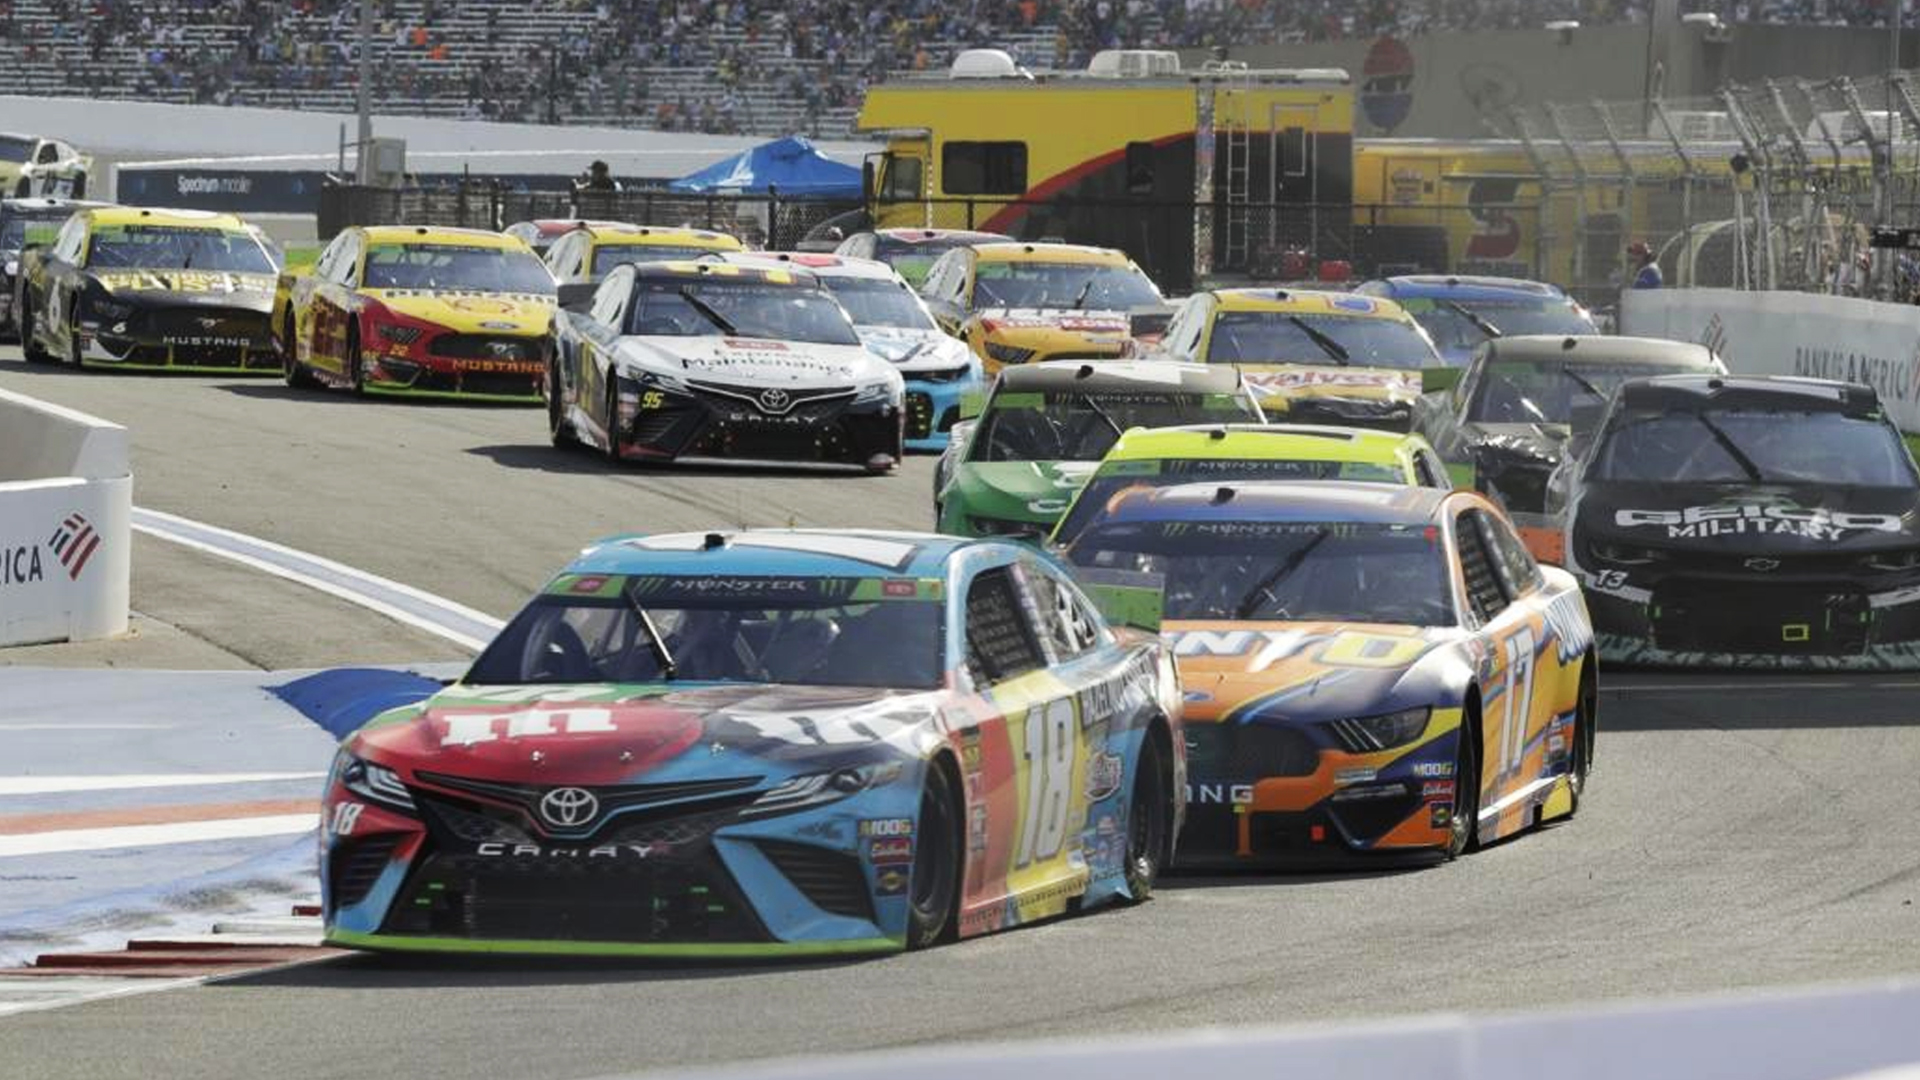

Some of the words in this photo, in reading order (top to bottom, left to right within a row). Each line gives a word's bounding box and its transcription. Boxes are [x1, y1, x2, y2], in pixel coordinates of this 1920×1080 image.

[177, 174, 219, 196] Spectrum
[112, 322, 127, 334] 6
[163, 336, 251, 346] MUSTANG
[452, 359, 546, 373] MUSTANG
[681, 357, 854, 377] Maintenance
[642, 391, 665, 409] 95
[1199, 461, 1301, 471] MONSTER
[1614, 505, 1902, 532] GEICO
[1668, 516, 1845, 541] MILITARY
[0, 545, 43, 584] ICA
[672, 579, 807, 592] MONSTER
[1596, 569, 1629, 588] 13
[1500, 626, 1537, 776] 17
[1412, 762, 1453, 776] MOOG
[1016, 697, 1076, 869] 18
[333, 802, 364, 835] 18
[477, 843, 654, 858] CAMRY
